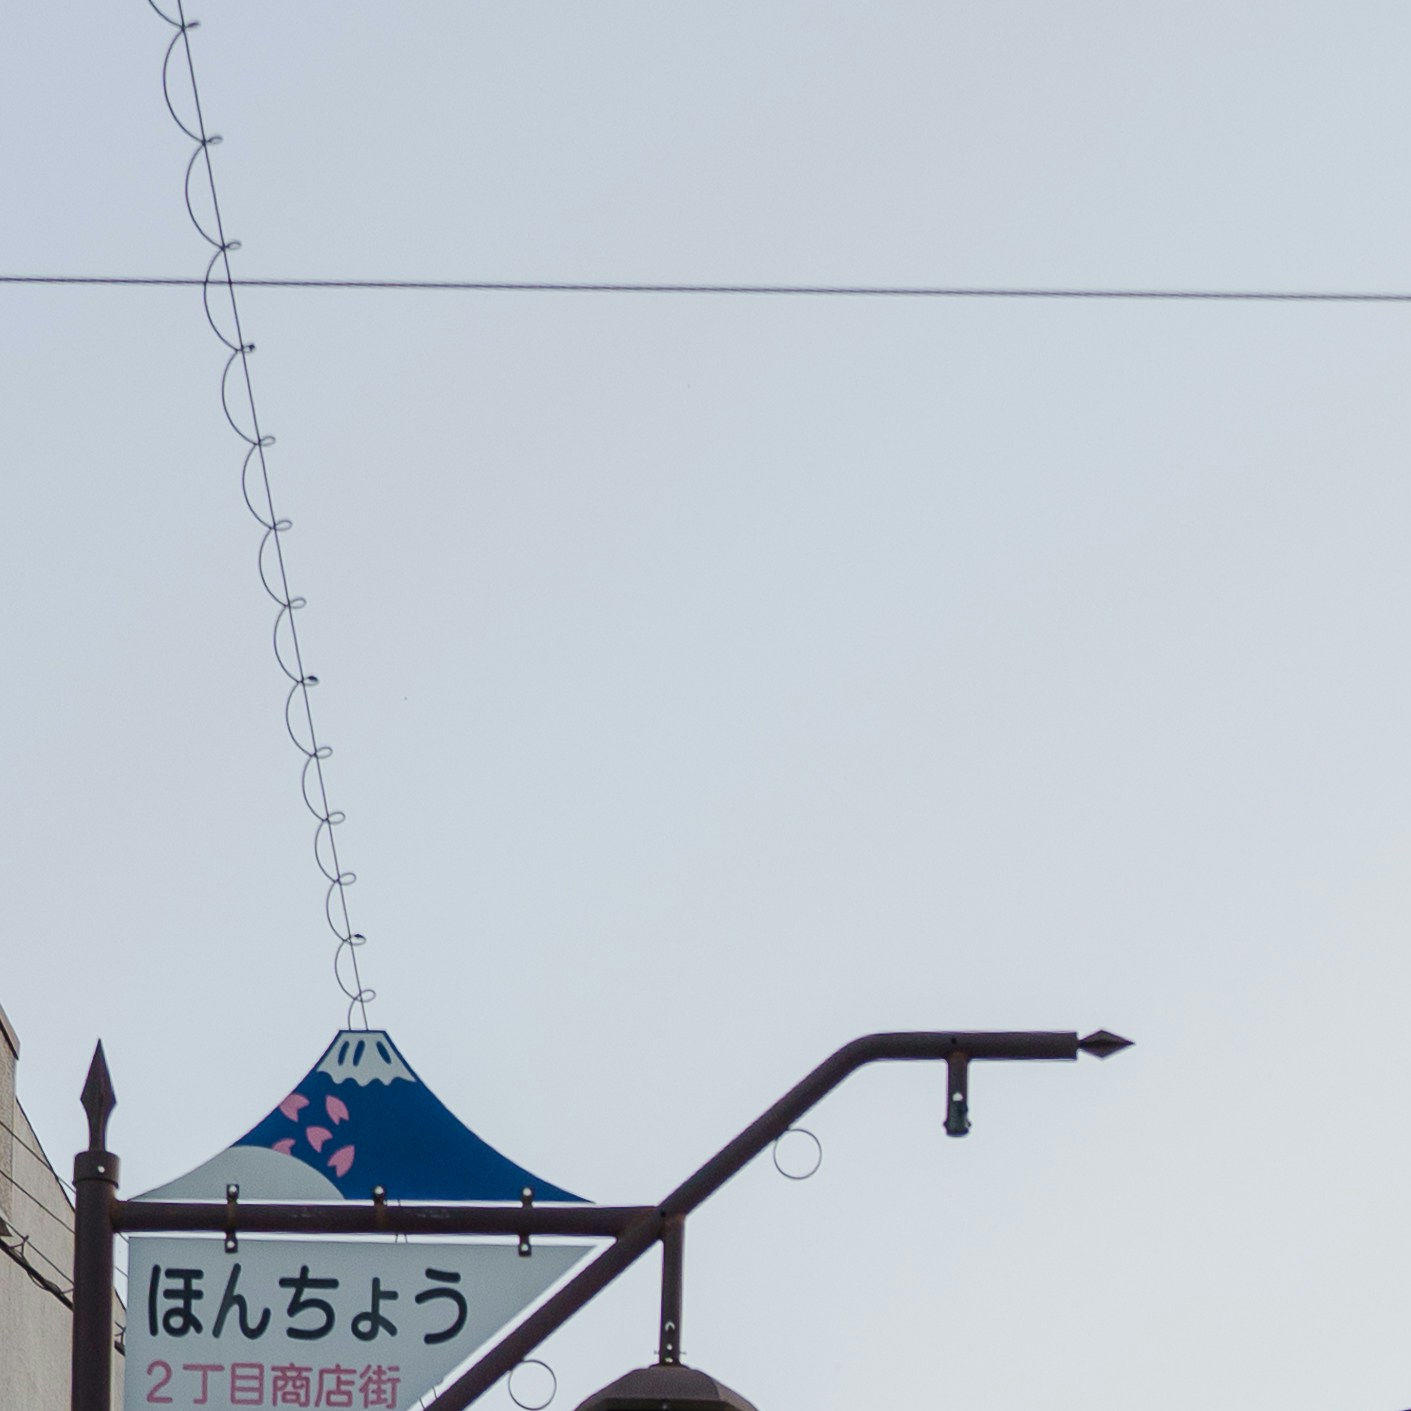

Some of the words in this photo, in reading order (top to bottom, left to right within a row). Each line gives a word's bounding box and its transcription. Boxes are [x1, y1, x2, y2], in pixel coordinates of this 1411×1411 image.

[147, 1264, 469, 1346] ほんちょう
[145, 1360, 401, 1410] 2丁目商店街
